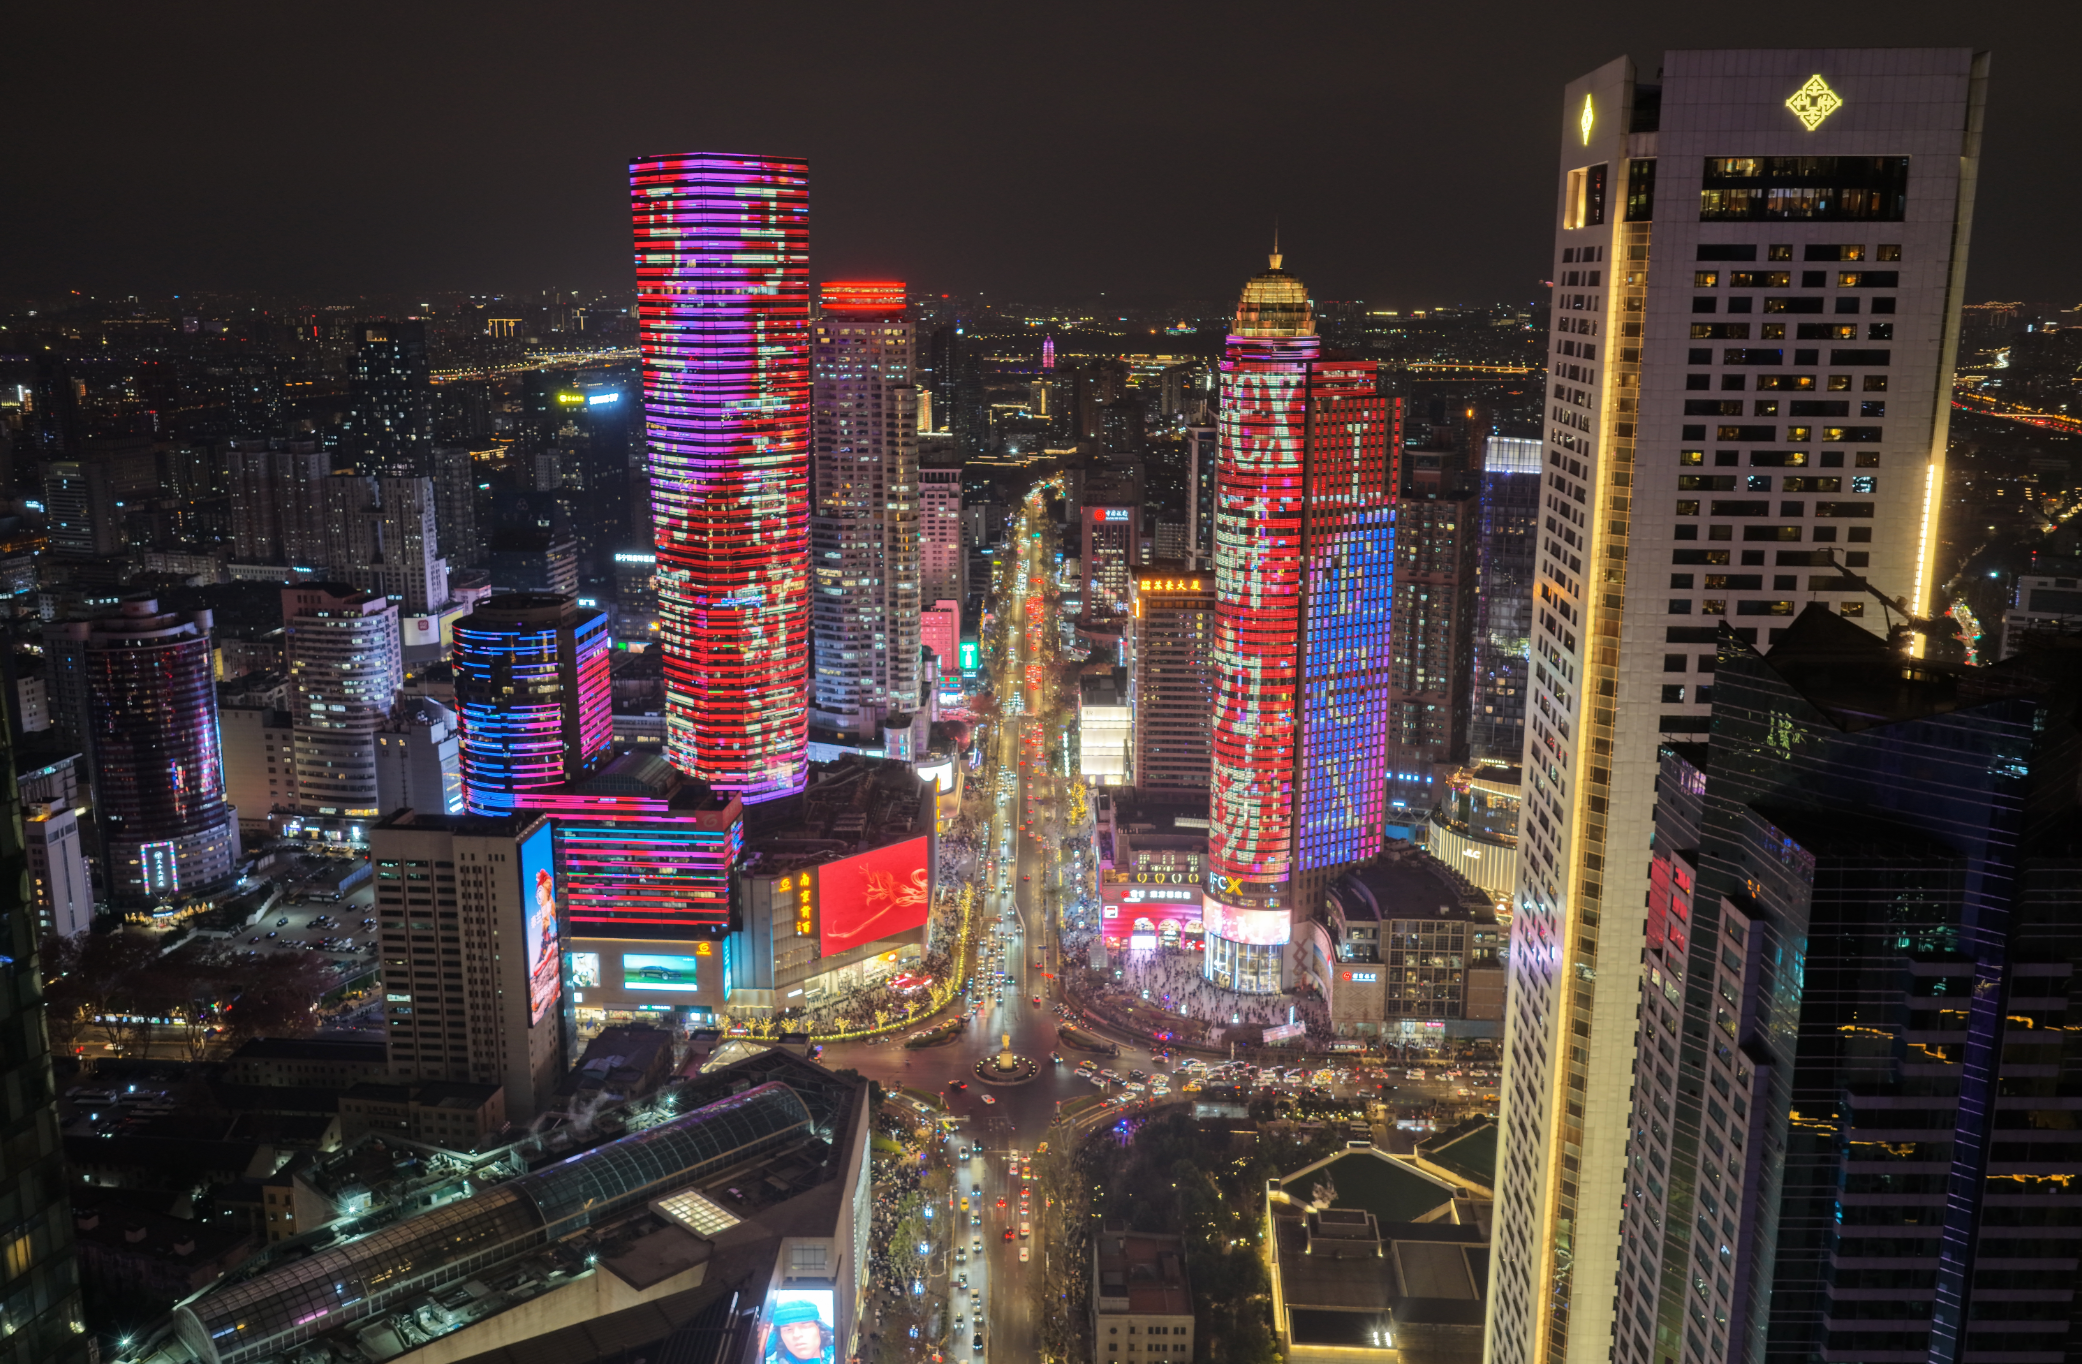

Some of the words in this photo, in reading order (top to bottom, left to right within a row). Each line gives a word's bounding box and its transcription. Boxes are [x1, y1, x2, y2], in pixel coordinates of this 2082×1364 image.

[1105, 509, 1129, 517] 中国银行
[1153, 579, 1202, 591] 苏豪大厦
[1463, 848, 1481, 859] JLC
[1209, 871, 1244, 897] IFCX
